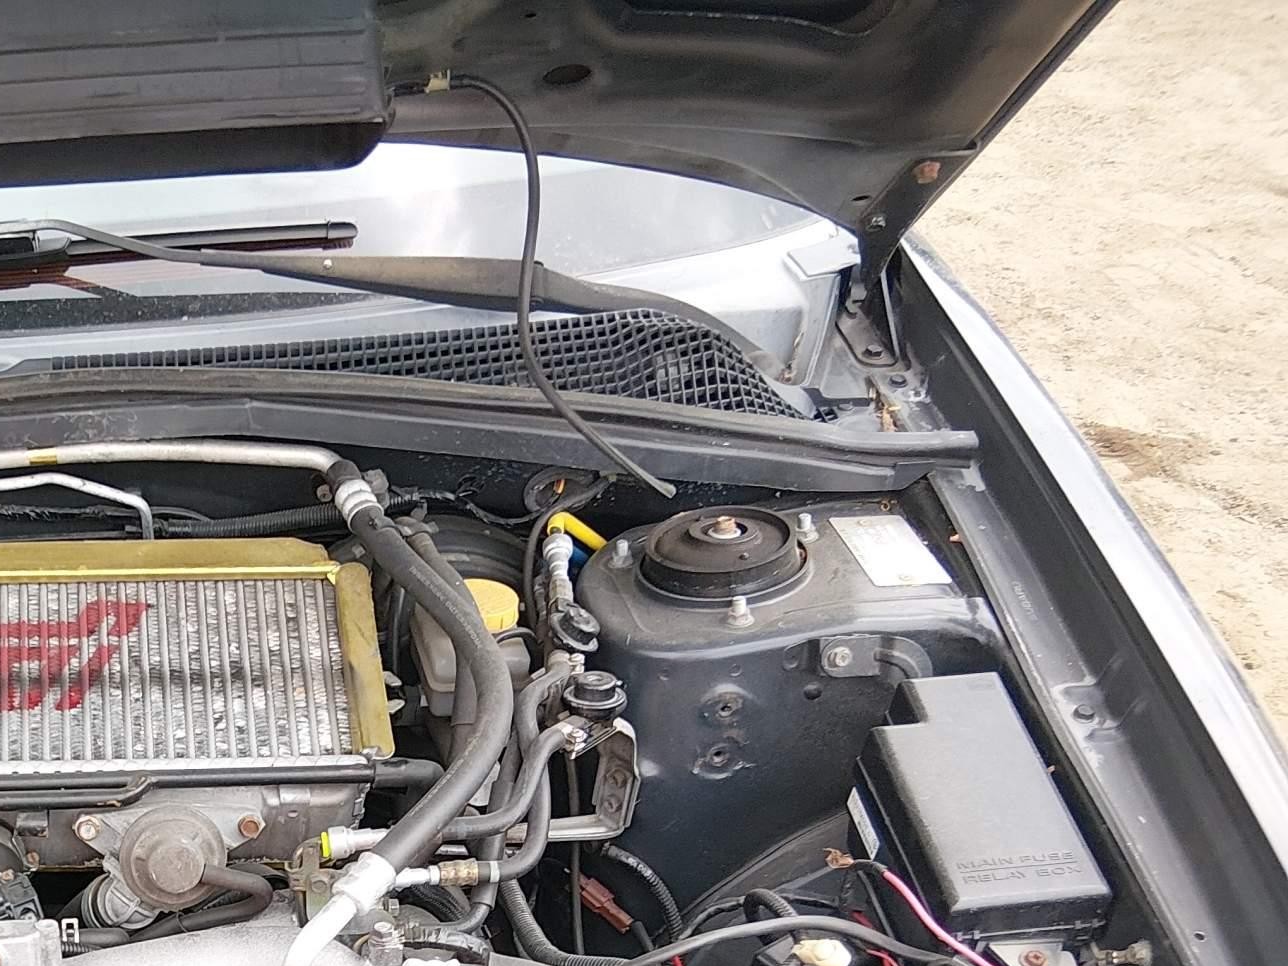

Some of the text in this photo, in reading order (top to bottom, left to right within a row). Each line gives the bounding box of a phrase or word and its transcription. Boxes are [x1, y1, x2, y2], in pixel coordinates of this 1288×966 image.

[955, 849, 1074, 870] MAIN FUSE
[962, 863, 1083, 885] RELAY BOX
